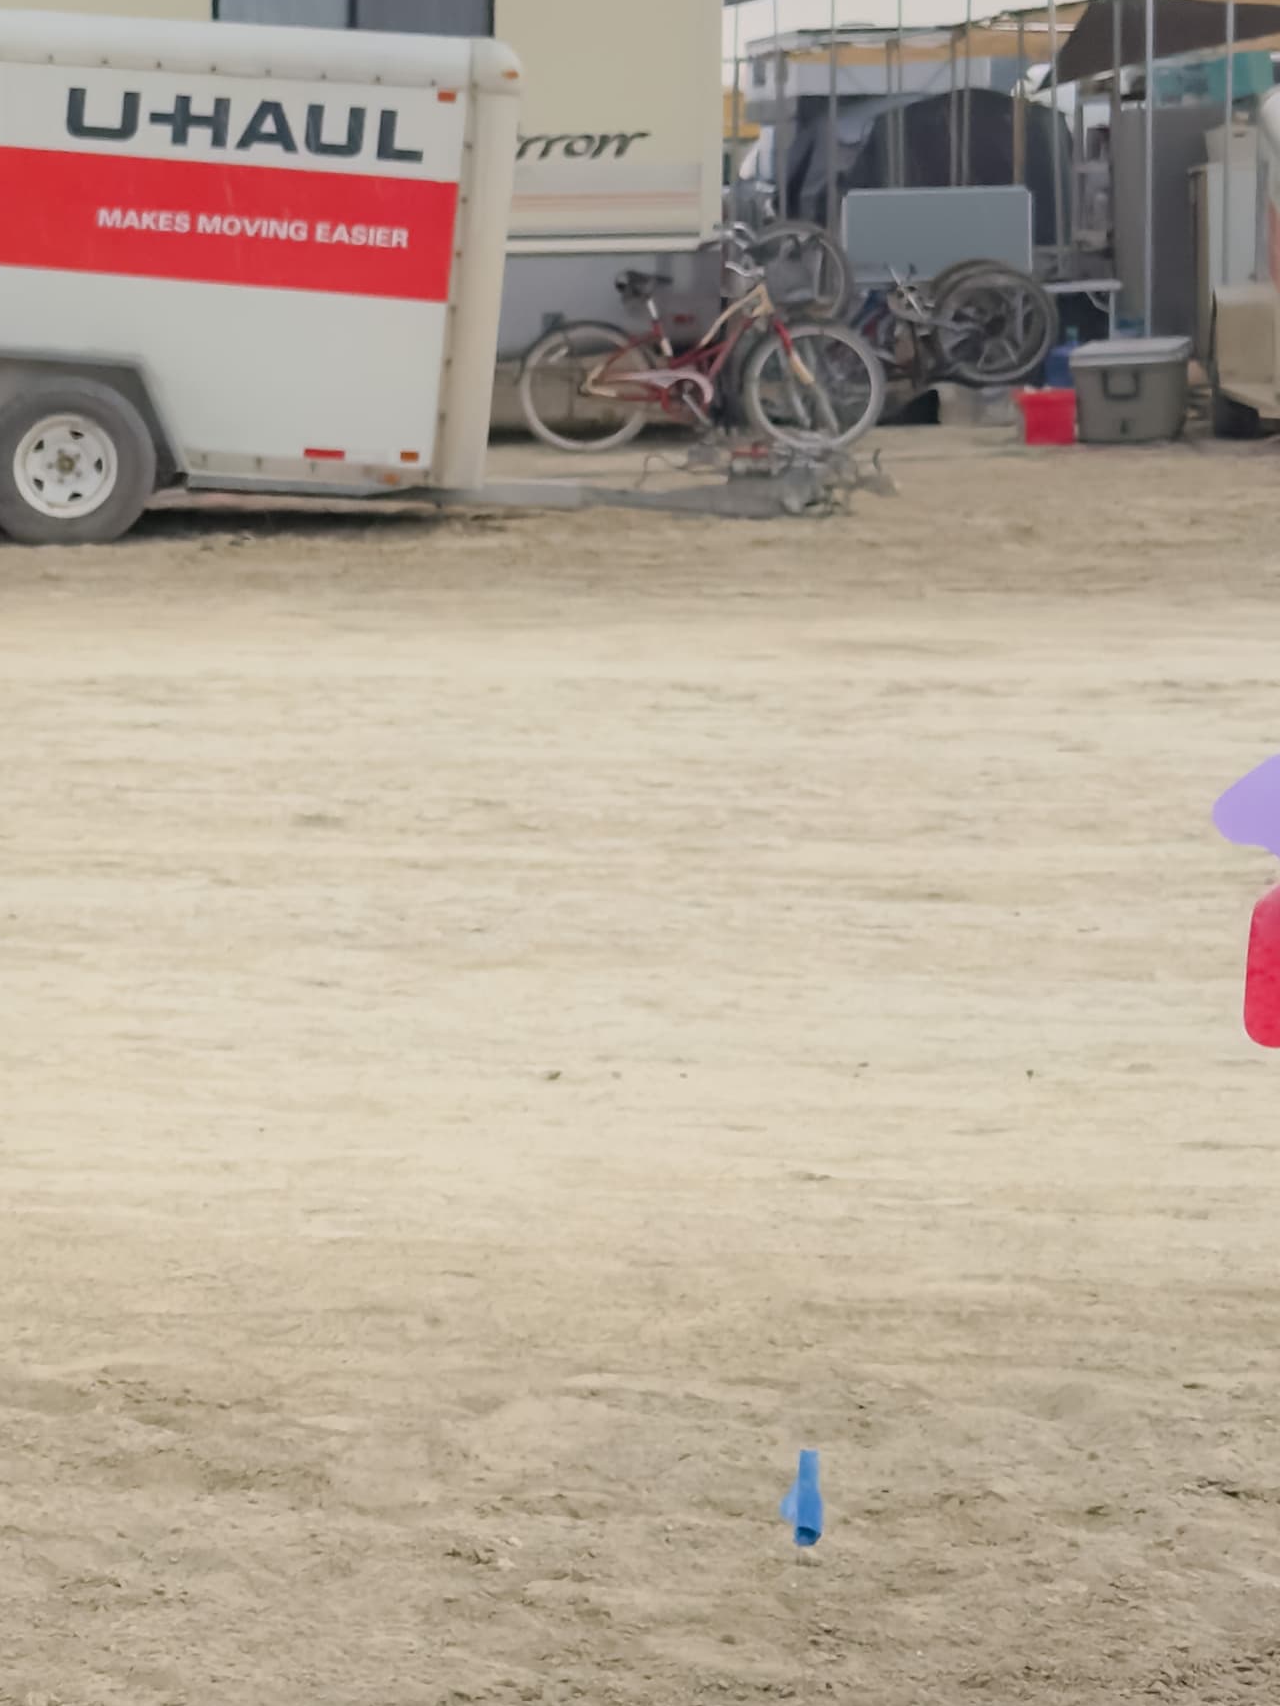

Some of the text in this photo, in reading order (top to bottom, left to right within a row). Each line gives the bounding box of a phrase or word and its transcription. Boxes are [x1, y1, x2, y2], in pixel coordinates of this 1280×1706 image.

[66, 87, 425, 162] U-HAUL
[516, 132, 652, 161] rrow
[96, 207, 410, 250] MAKES MOVING EASIER
